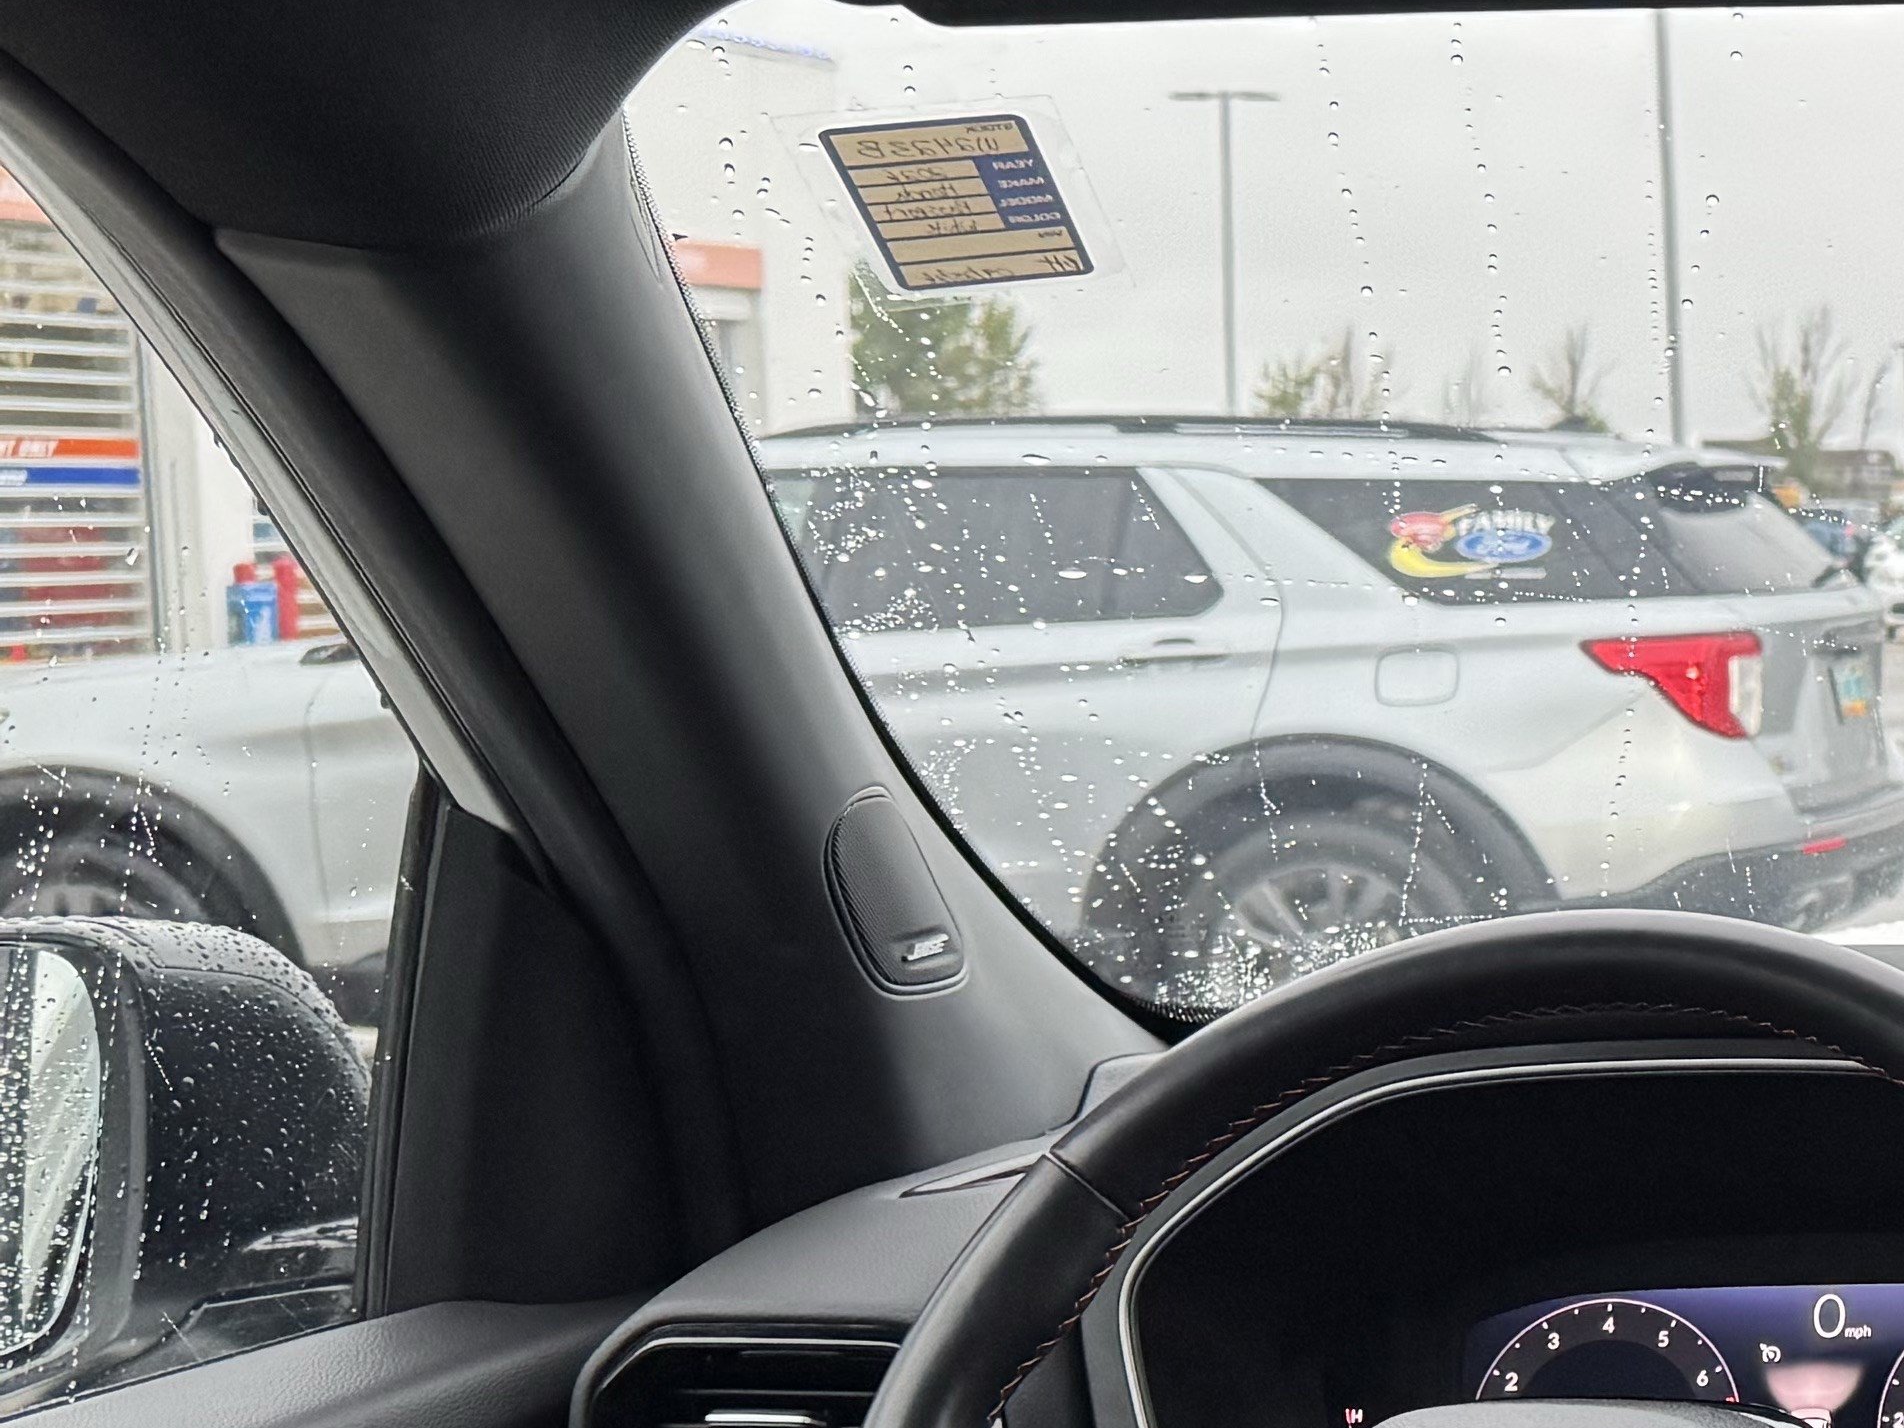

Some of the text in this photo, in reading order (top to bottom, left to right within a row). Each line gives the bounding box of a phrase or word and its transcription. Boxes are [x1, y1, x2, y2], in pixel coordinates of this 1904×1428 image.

[1602, 1317, 1615, 1334] 4
[1812, 1293, 1872, 1341] 0 mph
[1548, 1332, 1560, 1350] 3
[1658, 1331, 1670, 1348] 5
[1504, 1372, 1519, 1392] 2
[1696, 1370, 1709, 1387] 6
